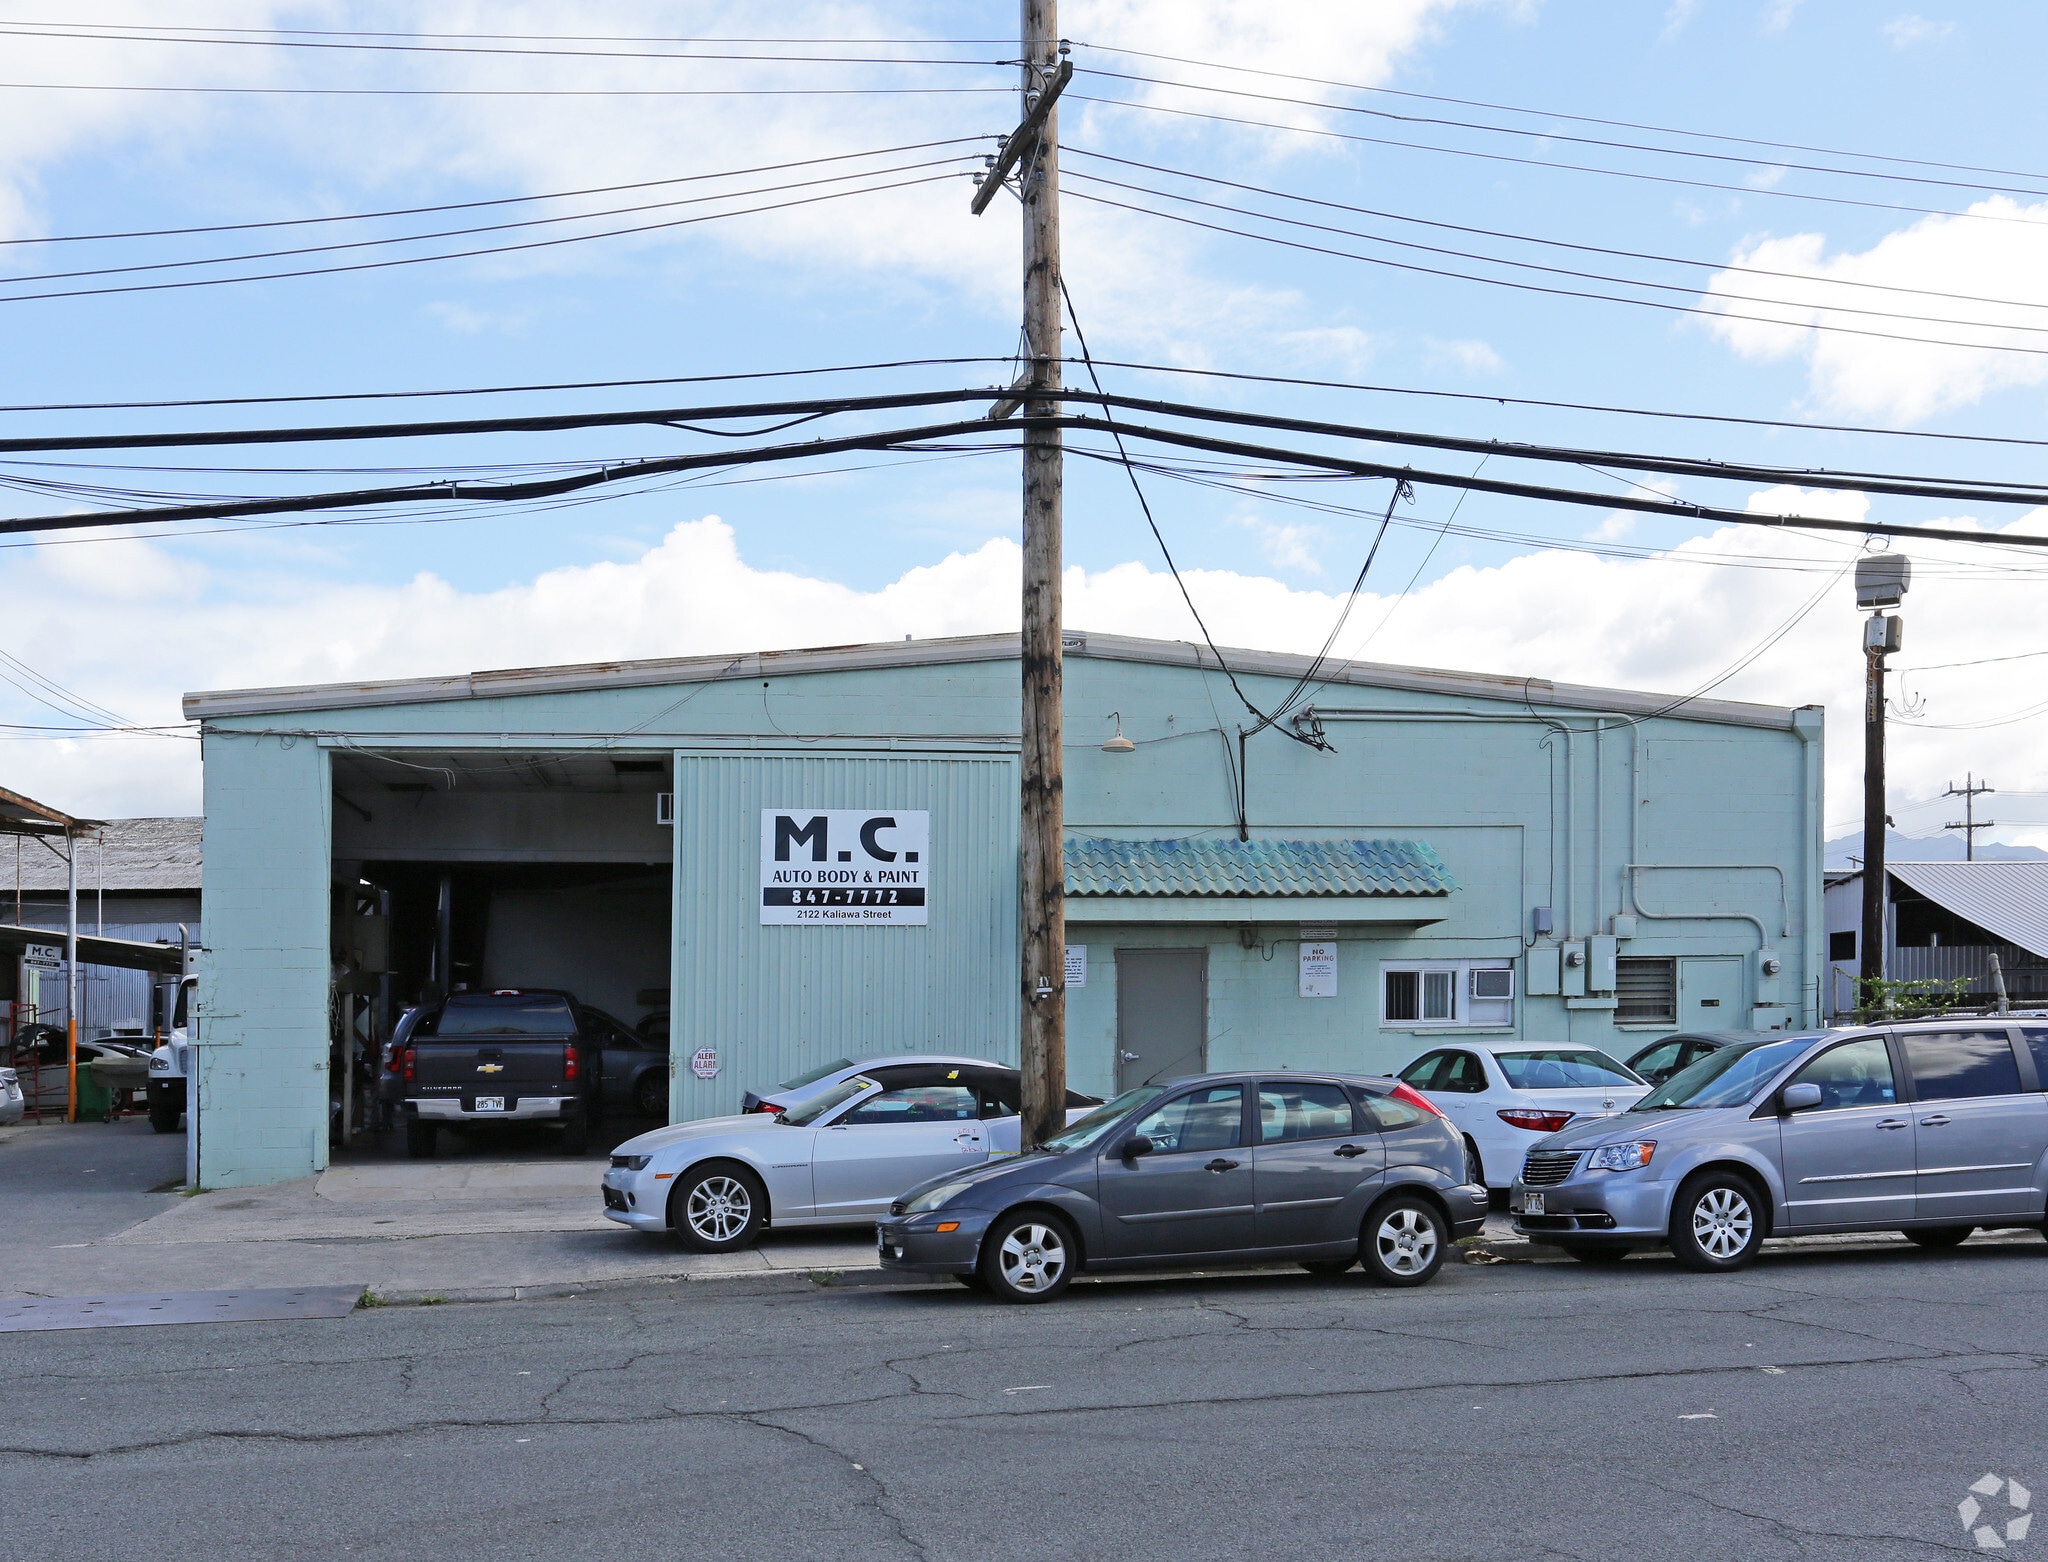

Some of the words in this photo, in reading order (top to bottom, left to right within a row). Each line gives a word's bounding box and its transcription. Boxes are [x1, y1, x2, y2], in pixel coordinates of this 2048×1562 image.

[774, 815, 919, 863] M.C.
[772, 869, 812, 883] AUTO
[817, 869, 859, 883] BODY
[863, 870, 873, 883] &
[878, 870, 919, 883] PAINT
[791, 889, 898, 904] 847-7772
[796, 910, 820, 919] 2122
[822, 910, 860, 919] Kaliawa
[863, 910, 892, 919] Street
[31, 946, 56, 958] M.C.
[697, 1052, 716, 1060] ALERT
